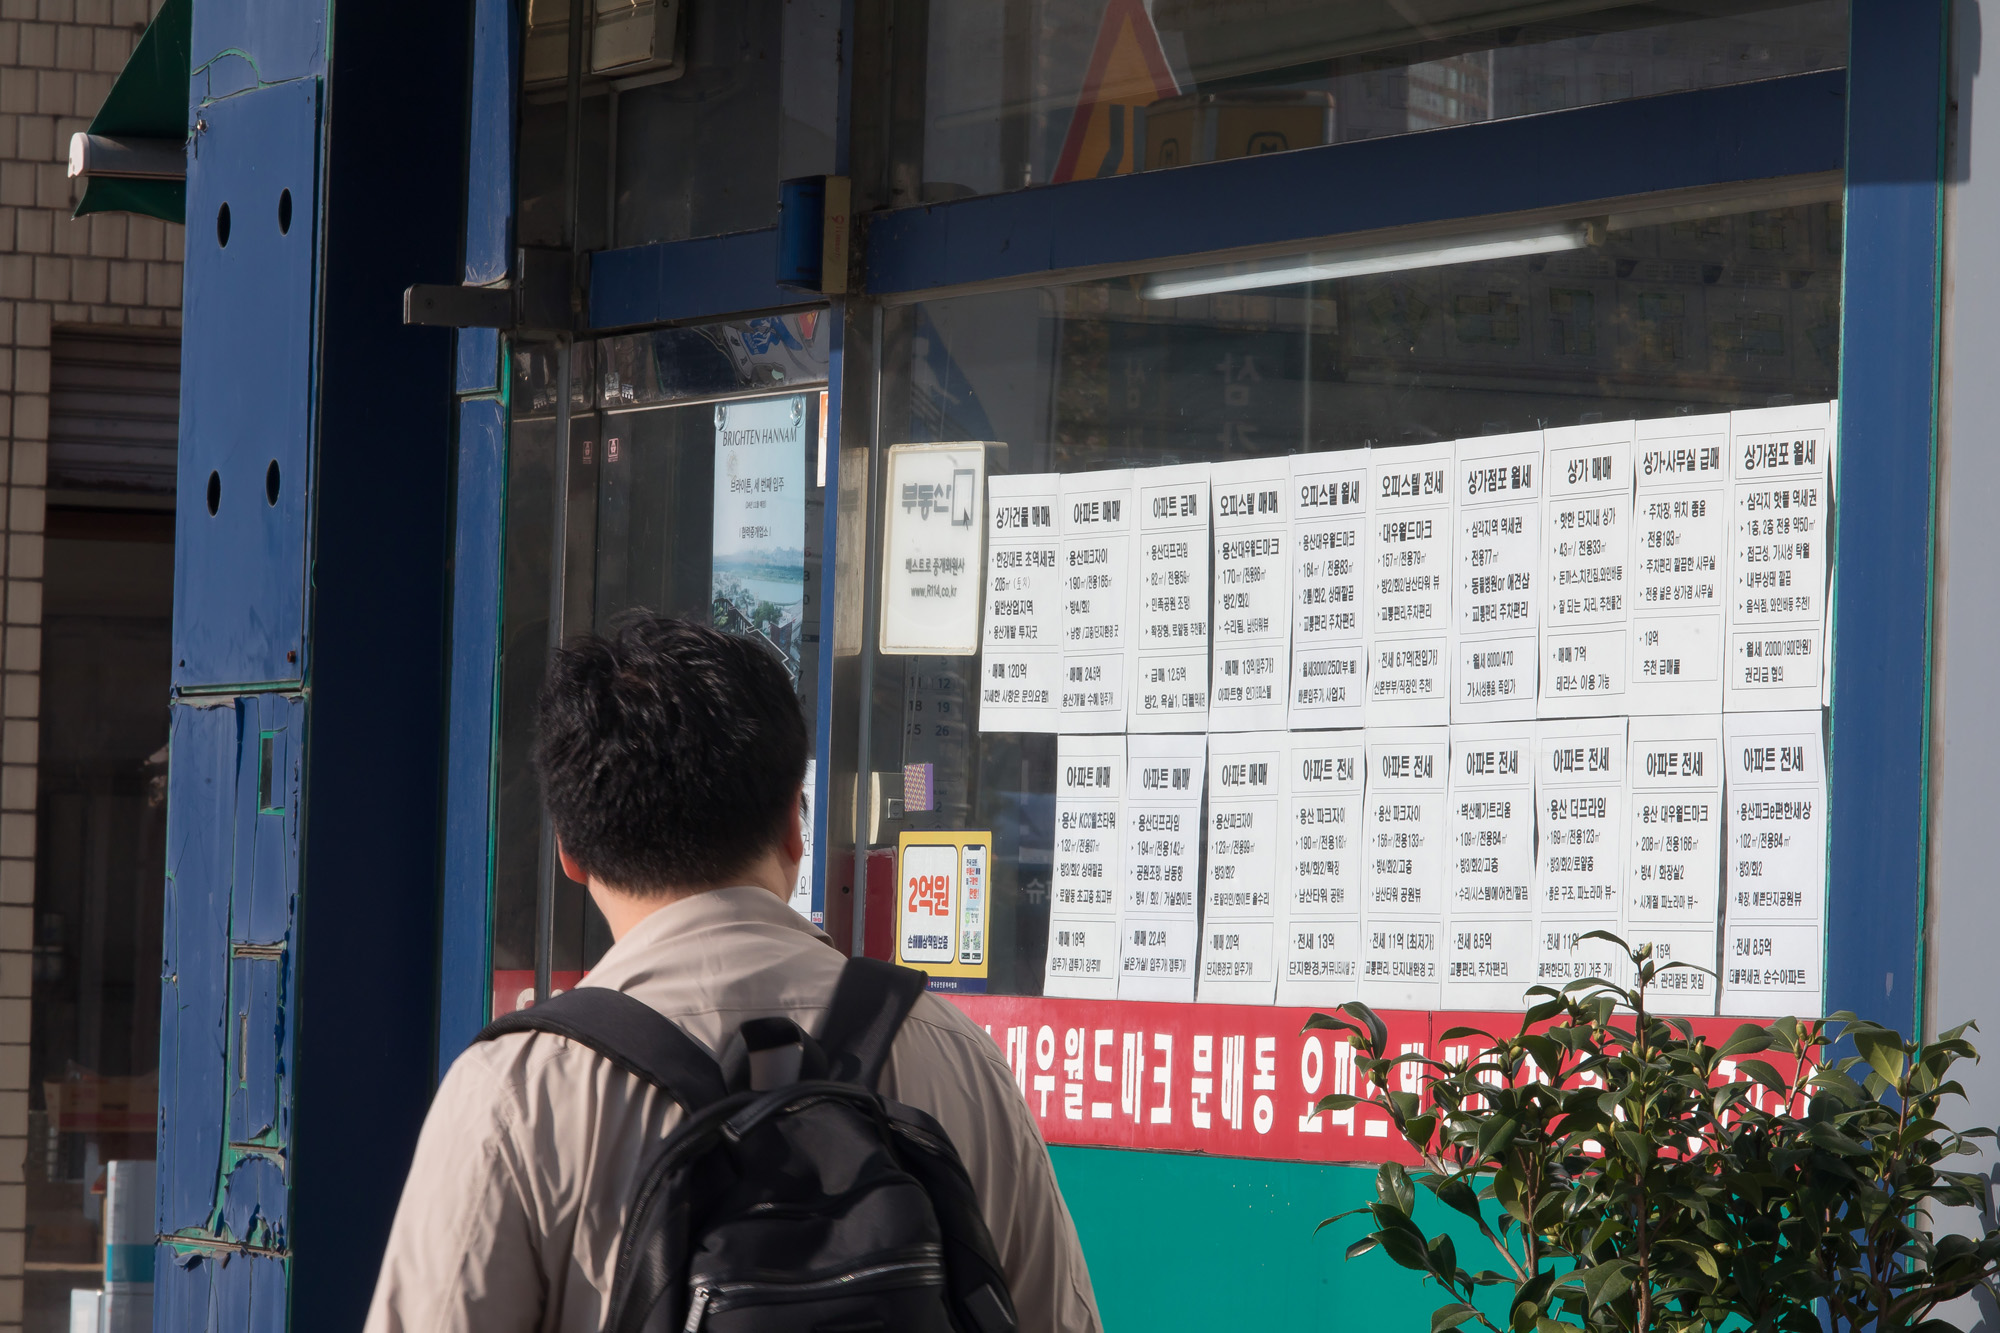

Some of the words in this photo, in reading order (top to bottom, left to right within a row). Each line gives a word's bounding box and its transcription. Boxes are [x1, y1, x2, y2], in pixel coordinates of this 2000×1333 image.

[722, 428, 760, 448] BRIGHTEN
[761, 427, 797, 444] HANNAM
[1744, 442, 1789, 470] 상가점포
[1793, 440, 1816, 465] 월세
[1468, 468, 1507, 495] 상가점포
[1511, 464, 1531, 489] 월세
[1568, 458, 1588, 484] 상가
[1592, 456, 1611, 481] 매매
[730, 478, 753, 494] 브라이튼,
[754, 477, 760, 492] 세
[761, 477, 772, 492] 번째
[773, 476, 785, 492] 입주
[1382, 473, 1420, 497] 오피스텔
[1424, 470, 1443, 495] 전세
[902, 483, 951, 520] 부동산
[1220, 493, 1255, 516] 오피스텔
[1258, 491, 1278, 514] 매매
[1301, 483, 1338, 507] 오피스텔
[1341, 481, 1359, 505] 월세
[1747, 492, 1770, 511] 삼각지
[1774, 491, 1789, 509] 핫플
[1793, 489, 1816, 507] 역세권
[1074, 502, 1099, 524] 아파트
[1103, 500, 1120, 522] 매매
[1153, 496, 1177, 519] 아파트
[1181, 494, 1197, 517] 급매
[1649, 502, 1671, 520] 주차장,
[1674, 501, 1688, 518] 위치
[1692, 500, 1705, 518] 좋음
[996, 507, 1028, 529] 상가건물
[1032, 506, 1050, 527] 매매
[1472, 519, 1498, 538] 삼각지역
[1501, 516, 1522, 535] 역세권
[1560, 511, 1575, 529] 핫한
[1578, 509, 1600, 528] 단지내
[1602, 507, 1615, 526] 상가
[742, 526, 768, 539] 협력중개업소
[1303, 531, 1355, 551] 용산대우월드마크
[1383, 520, 1432, 543] 대우월드마크
[1070, 548, 1107, 566] 용산파크자이
[1152, 542, 1188, 561] 용산더프라임
[1222, 538, 1279, 560] 용산대우월드마크
[1747, 545, 1770, 562] 접근성,
[1773, 544, 1793, 560] 가시성
[1796, 543, 1809, 559] 탁월
[932, 557, 965, 577] 중개회원사
[996, 551, 1022, 568] 한강대로
[1025, 550, 1055, 567] 초역세권
[1646, 558, 1672, 573] 주차편리
[1674, 557, 1694, 572] 깔끔한
[1696, 555, 1715, 571] 사무실
[1747, 571, 1776, 588] 내부상태
[1779, 570, 1791, 586] 깔끔
[995, 600, 1033, 615] 일반상업지역
[1152, 597, 1176, 612] 민족공원
[1178, 596, 1190, 610] 조망
[1472, 604, 1497, 622] 교통편리
[1500, 601, 1528, 620] 주차편리
[1304, 615, 1327, 632] 교통편리
[1329, 612, 1355, 630] 주차편리
[994, 625, 1016, 639] 용산개발
[1019, 625, 1037, 639] 투자굿
[1645, 630, 1658, 646] 19억
[1558, 647, 1572, 663] 매매
[1574, 646, 1586, 661] 7억
[992, 664, 1005, 678] 매매
[1008, 664, 1027, 678] 120억
[1151, 668, 1165, 682] 급매
[1644, 660, 1657, 675] 추천
[1660, 659, 1680, 675] 급매물
[1745, 667, 1769, 683] 권리금
[1771, 666, 1783, 682] 협의
[1556, 676, 1577, 691] 테라스
[1581, 674, 1595, 690] 이용
[1598, 674, 1609, 689] 가능
[1145, 695, 1158, 709] 방2,
[1161, 694, 1179, 708] 욕실1,
[1383, 755, 1410, 778] 아파트
[1414, 755, 1433, 778] 전세
[1466, 752, 1494, 776] 아파트
[1499, 750, 1518, 774] 전세
[1553, 749, 1584, 773] 아파트
[1588, 747, 1609, 771] 전세
[1647, 753, 1678, 777] 아파트
[1682, 752, 1703, 776] 전세
[1744, 748, 1775, 773] 아파트
[1780, 746, 1804, 772] 전세
[1067, 767, 1093, 788] 아파트
[1096, 766, 1111, 788] 매매
[1143, 768, 1168, 790] 아파트
[1172, 768, 1190, 790] 매매
[1222, 764, 1246, 787] 아파트
[1249, 763, 1268, 786] 매매
[1303, 759, 1332, 782] 아파트
[1337, 758, 1354, 781] 전세
[1300, 808, 1314, 825] 용산
[1317, 808, 1345, 824] 파크자이
[1379, 805, 1391, 822] 용산
[1393, 805, 1420, 822] 파크자이
[1461, 802, 1511, 820] 벽산메가트리움
[1551, 799, 1567, 820] 용산
[1571, 797, 1606, 819] 더프라임
[1643, 806, 1658, 823] 용산
[1661, 805, 1708, 823] 대우월드마크
[1741, 801, 1812, 821] 용산파크e편한세상
[1138, 814, 1180, 832] 용산더프라임
[1216, 813, 1253, 830] 용산파크자이
[1739, 861, 1762, 877] 방3/화2
[908, 875, 950, 916] 2억원
[1059, 931, 1070, 947] 매매
[1072, 932, 1085, 947] 18억
[1214, 935, 1224, 950] 매매
[1226, 934, 1239, 950] 20억
[1298, 933, 1314, 949] 전세
[1318, 933, 1334, 949] 13억
[1373, 933, 1385, 949] 전세
[1389, 933, 1404, 950] 11억
[1457, 933, 1471, 950] 전세
[1474, 933, 1492, 950] 8.5억
[1736, 938, 1750, 956] 전세
[1753, 938, 1772, 956] 8.5억
[1656, 944, 1670, 959] 15억
[1479, 962, 1508, 976] 주차편리
[1006, 1024, 1173, 1125] 대우월드마크
[1191, 1034, 1276, 1135] 문배동
